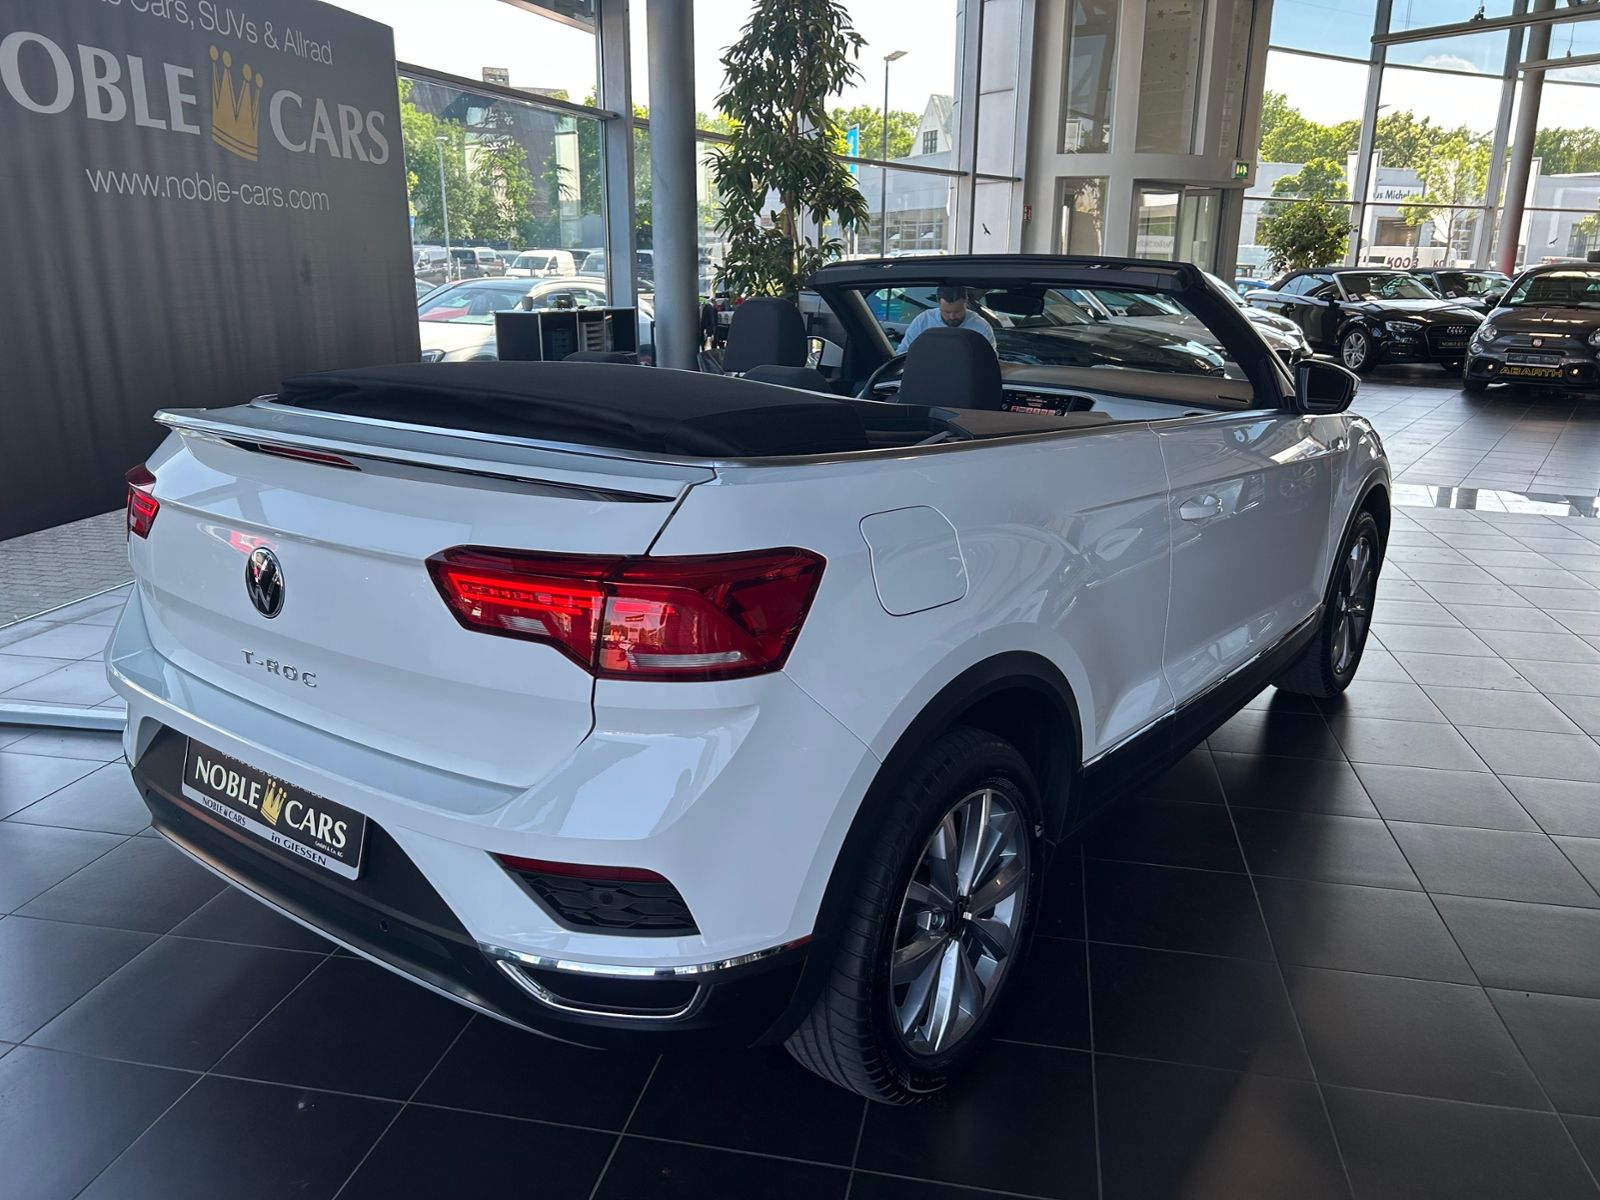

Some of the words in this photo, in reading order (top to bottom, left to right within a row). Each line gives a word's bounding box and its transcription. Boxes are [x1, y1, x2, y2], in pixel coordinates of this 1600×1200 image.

[199, 1, 257, 44] SUVs
[264, 27, 279, 50] &
[284, 27, 334, 65] Allrad
[269, 90, 390, 165] CARS
[86, 168, 330, 211] www.noble-cars.com
[1500, 366, 1563, 378] ABARTH
[241, 648, 318, 688] T-ROC
[195, 755, 261, 810] NOBLE
[284, 799, 348, 848] CARS
[202, 797, 224, 814] NOBLE
[228, 810, 246, 826] CARS
[271, 832, 281, 844] in
[283, 839, 327, 866] GIESSEN
